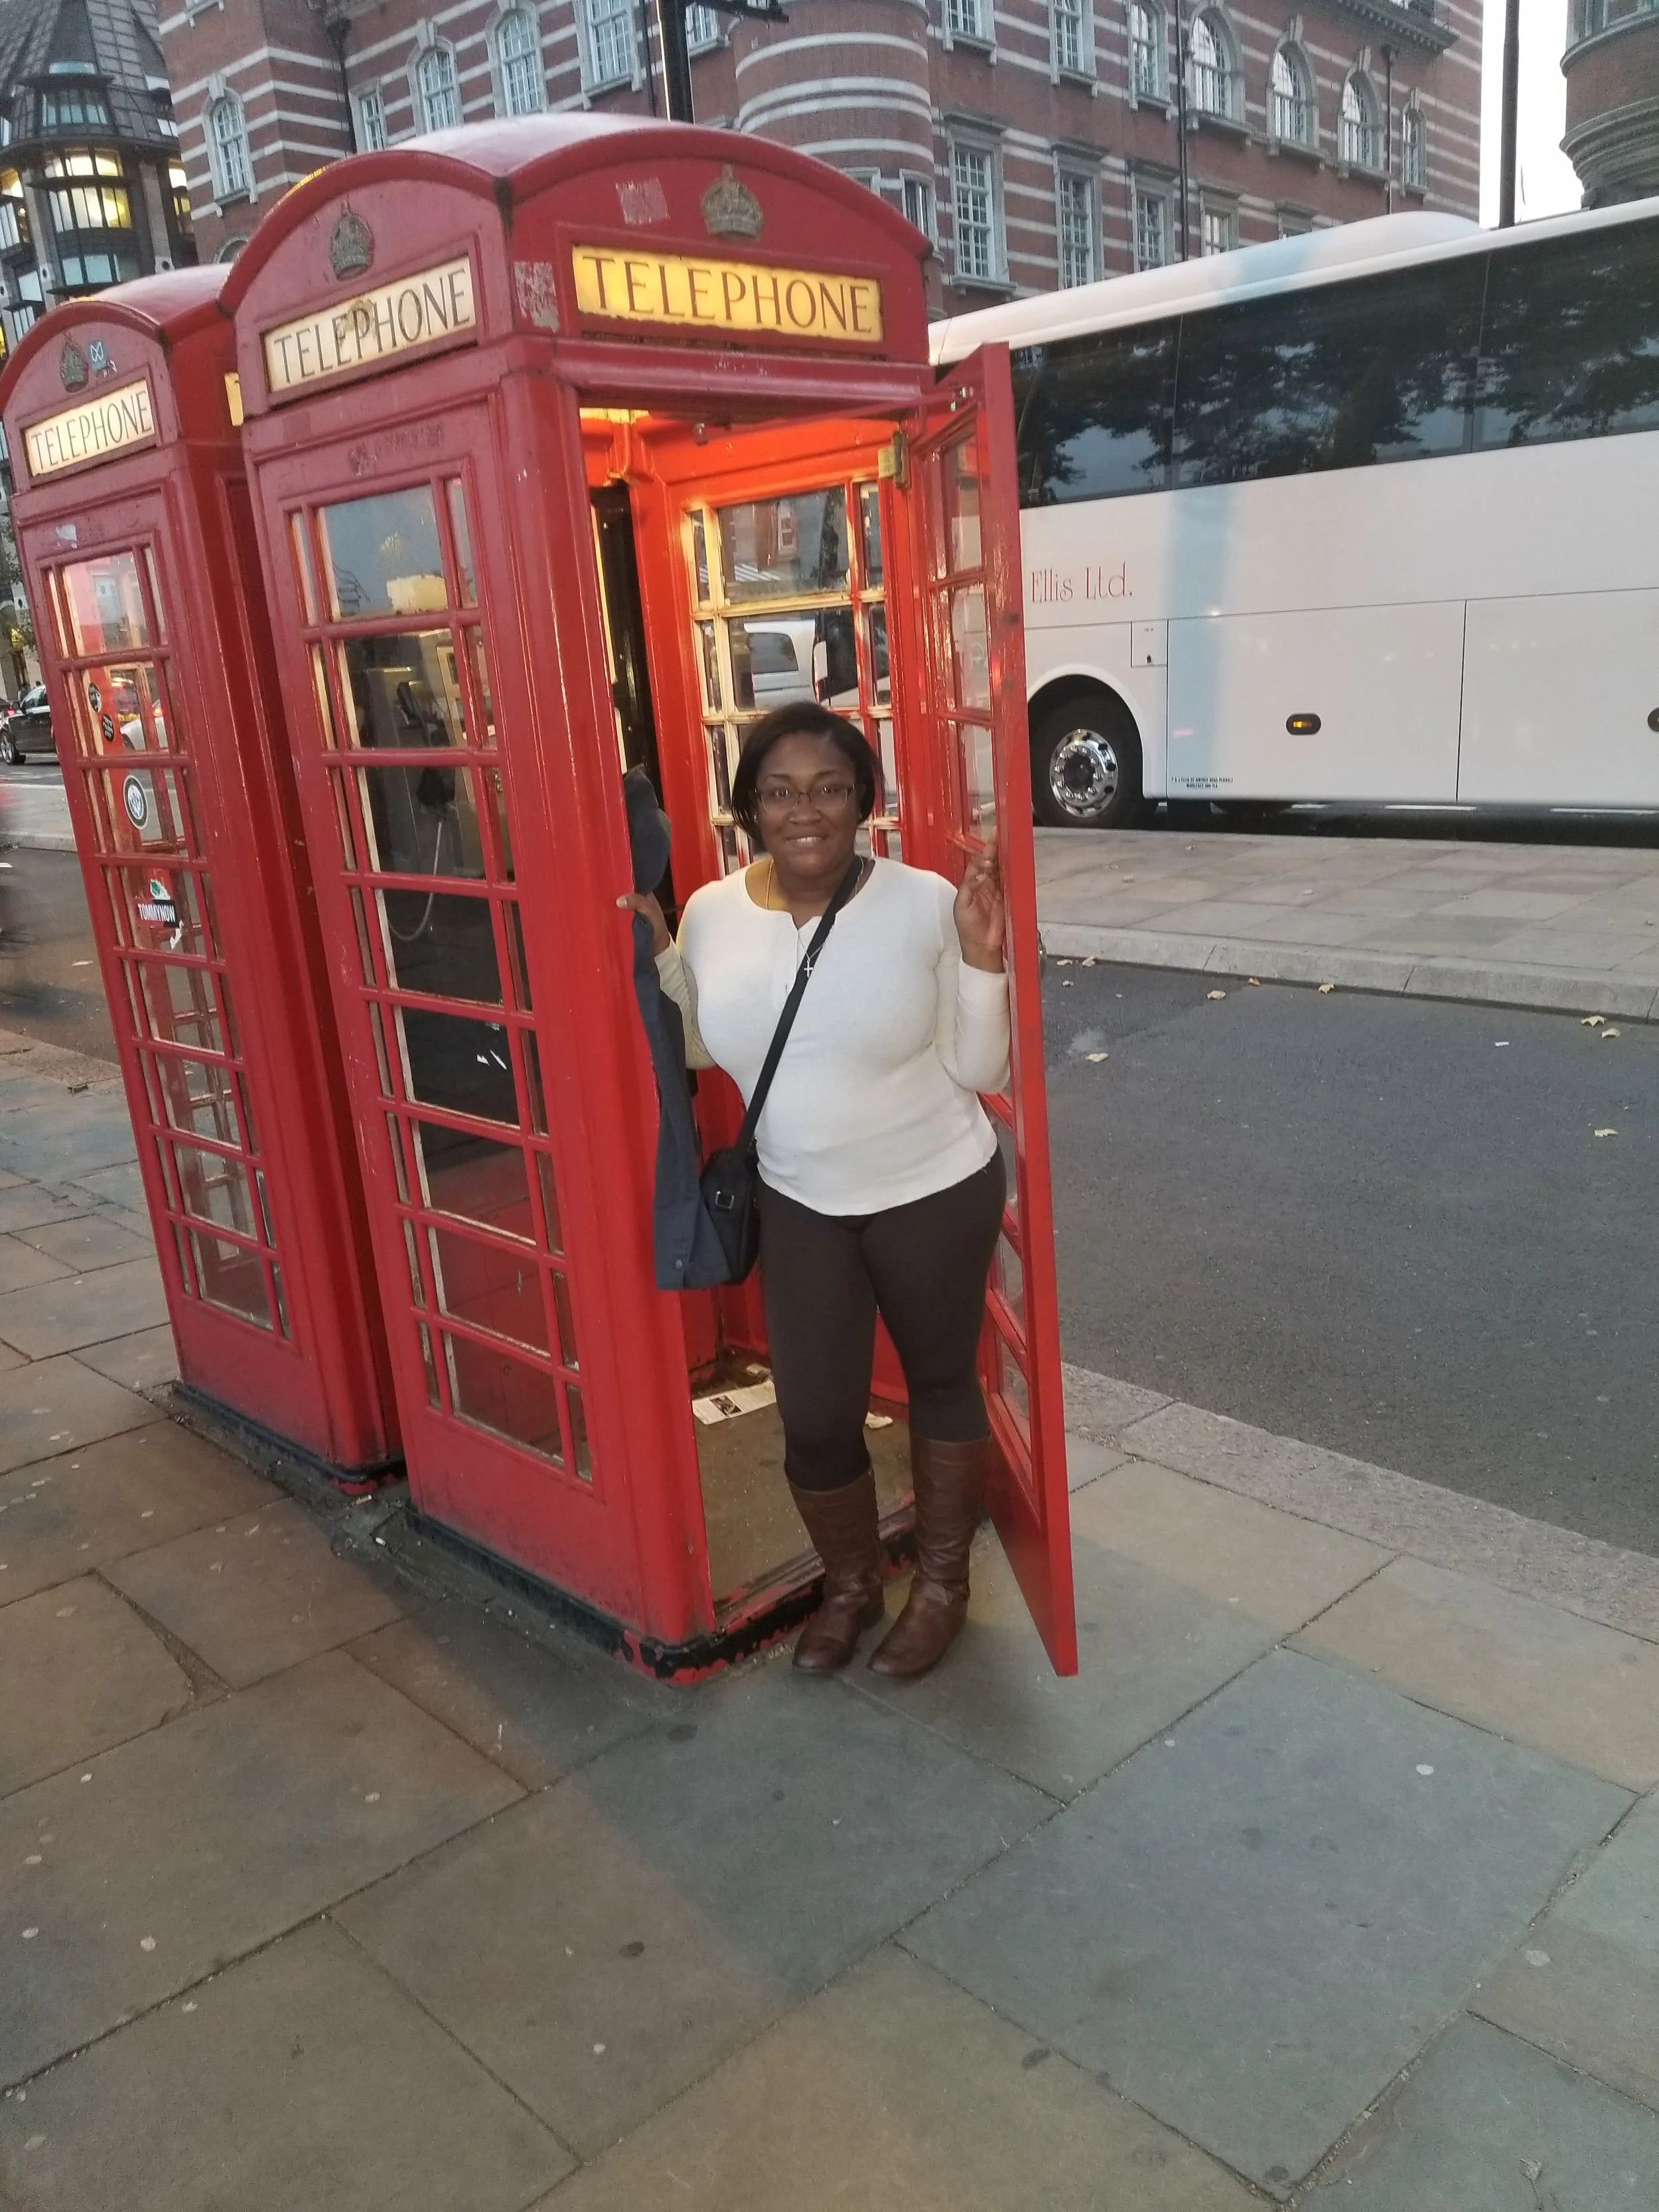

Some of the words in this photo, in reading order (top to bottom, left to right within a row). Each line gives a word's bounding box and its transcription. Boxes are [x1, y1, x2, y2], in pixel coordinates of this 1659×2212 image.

[273, 268, 470, 384] TELEPHONE
[583, 256, 872, 332] TELEPHONE
[31, 390, 152, 470] TELEPHONE
[1030, 567, 1073, 604] Ellis
[1084, 560, 1133, 601] Ltd.
[137, 903, 176, 922] TOMMYNOW
